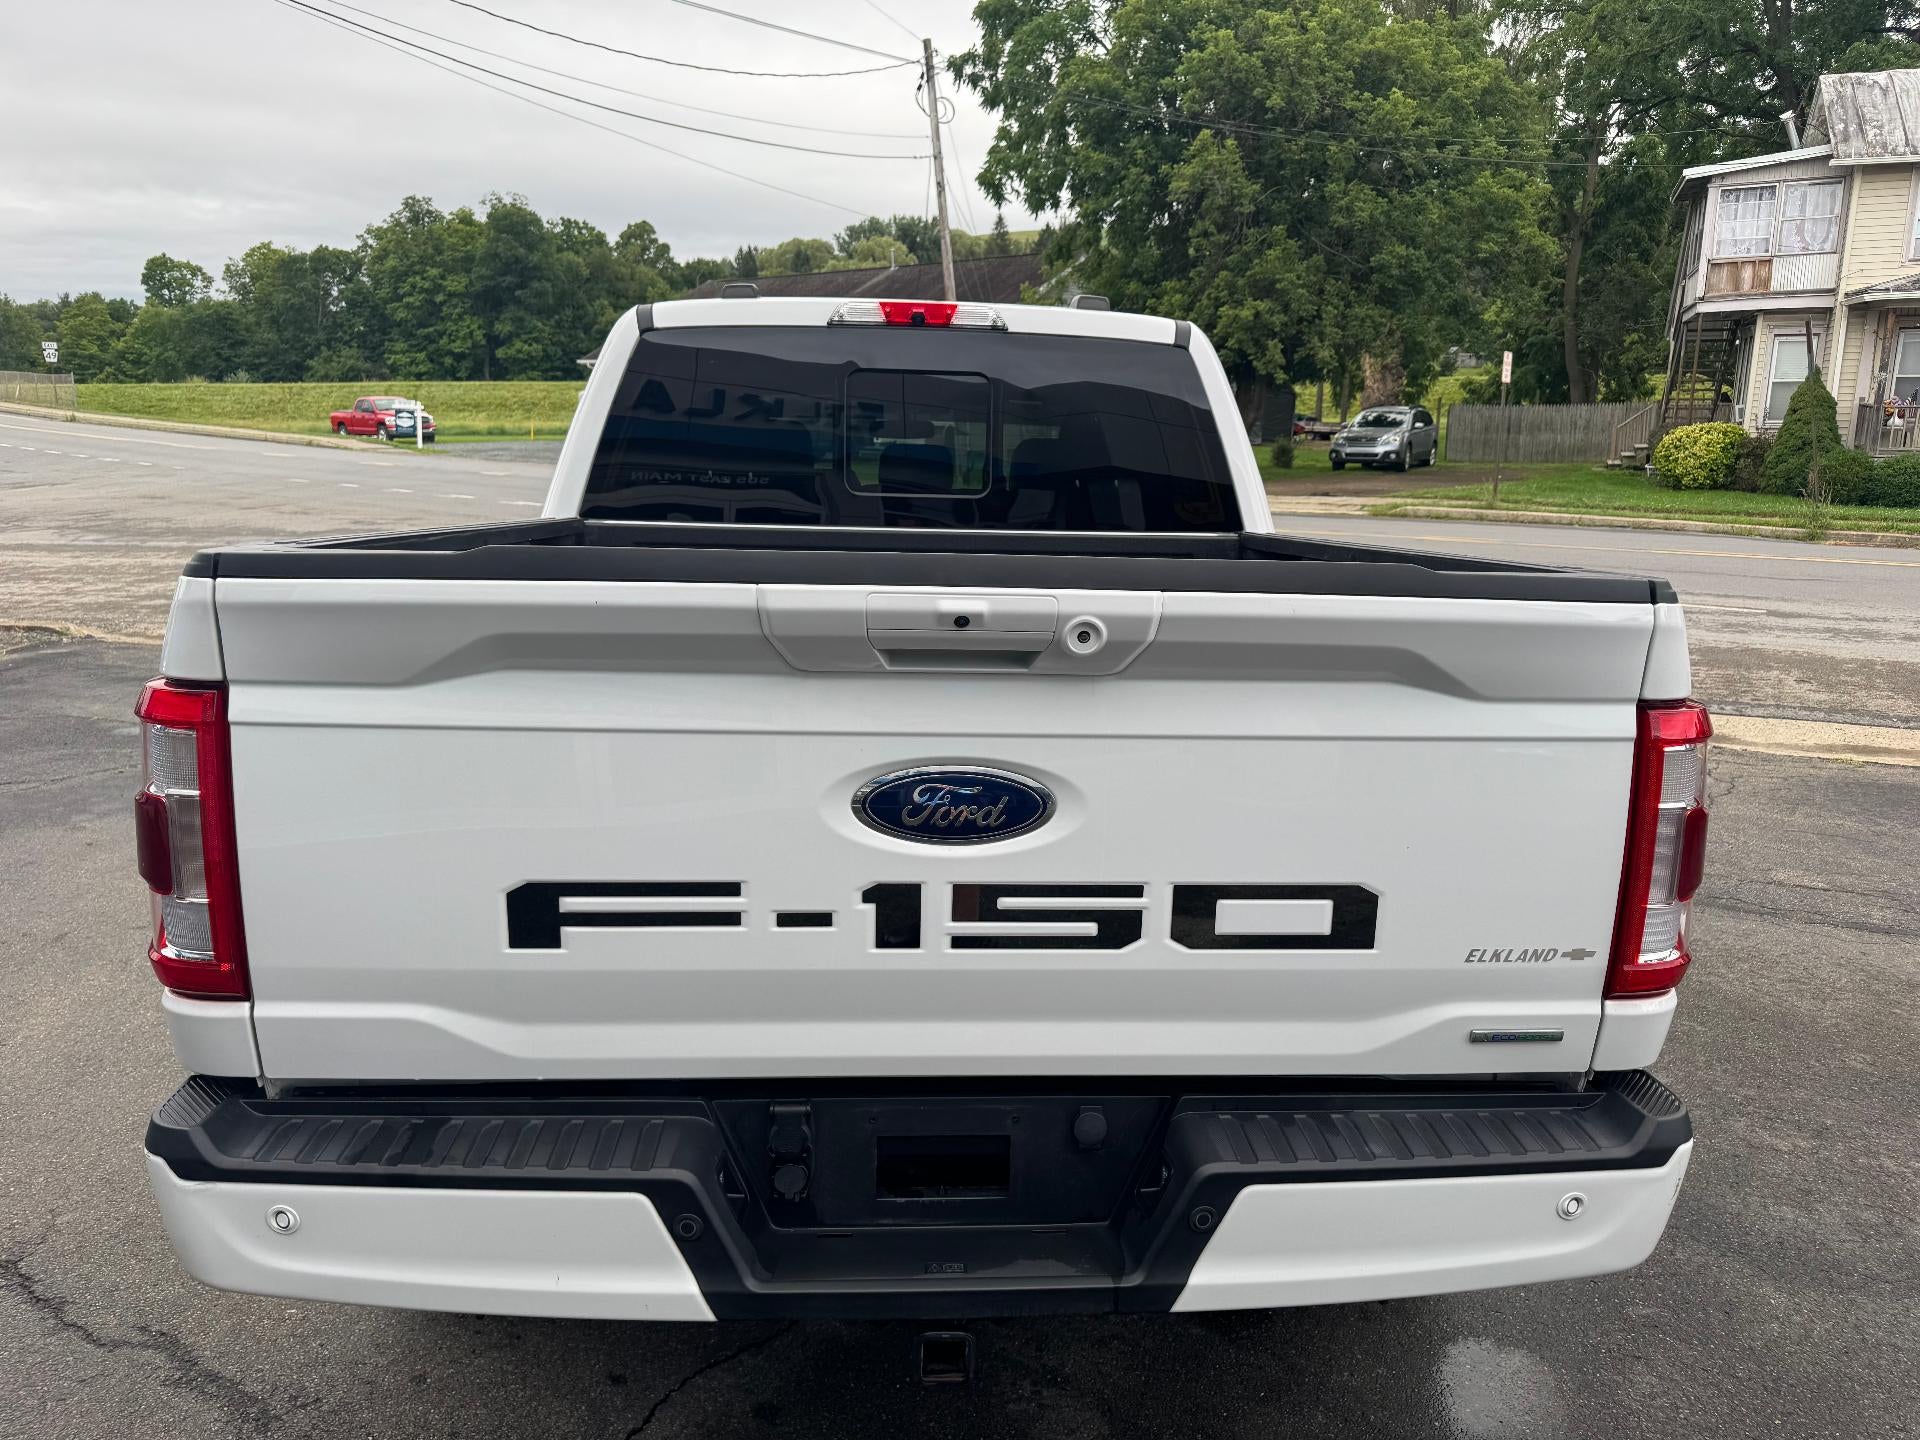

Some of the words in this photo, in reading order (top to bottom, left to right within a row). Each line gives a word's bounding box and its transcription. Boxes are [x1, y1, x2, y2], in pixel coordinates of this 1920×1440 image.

[45, 352, 57, 360] 49
[901, 783, 1009, 828] Ford
[506, 881, 1379, 949] F-150
[1464, 948, 1559, 963] ELKLAND
